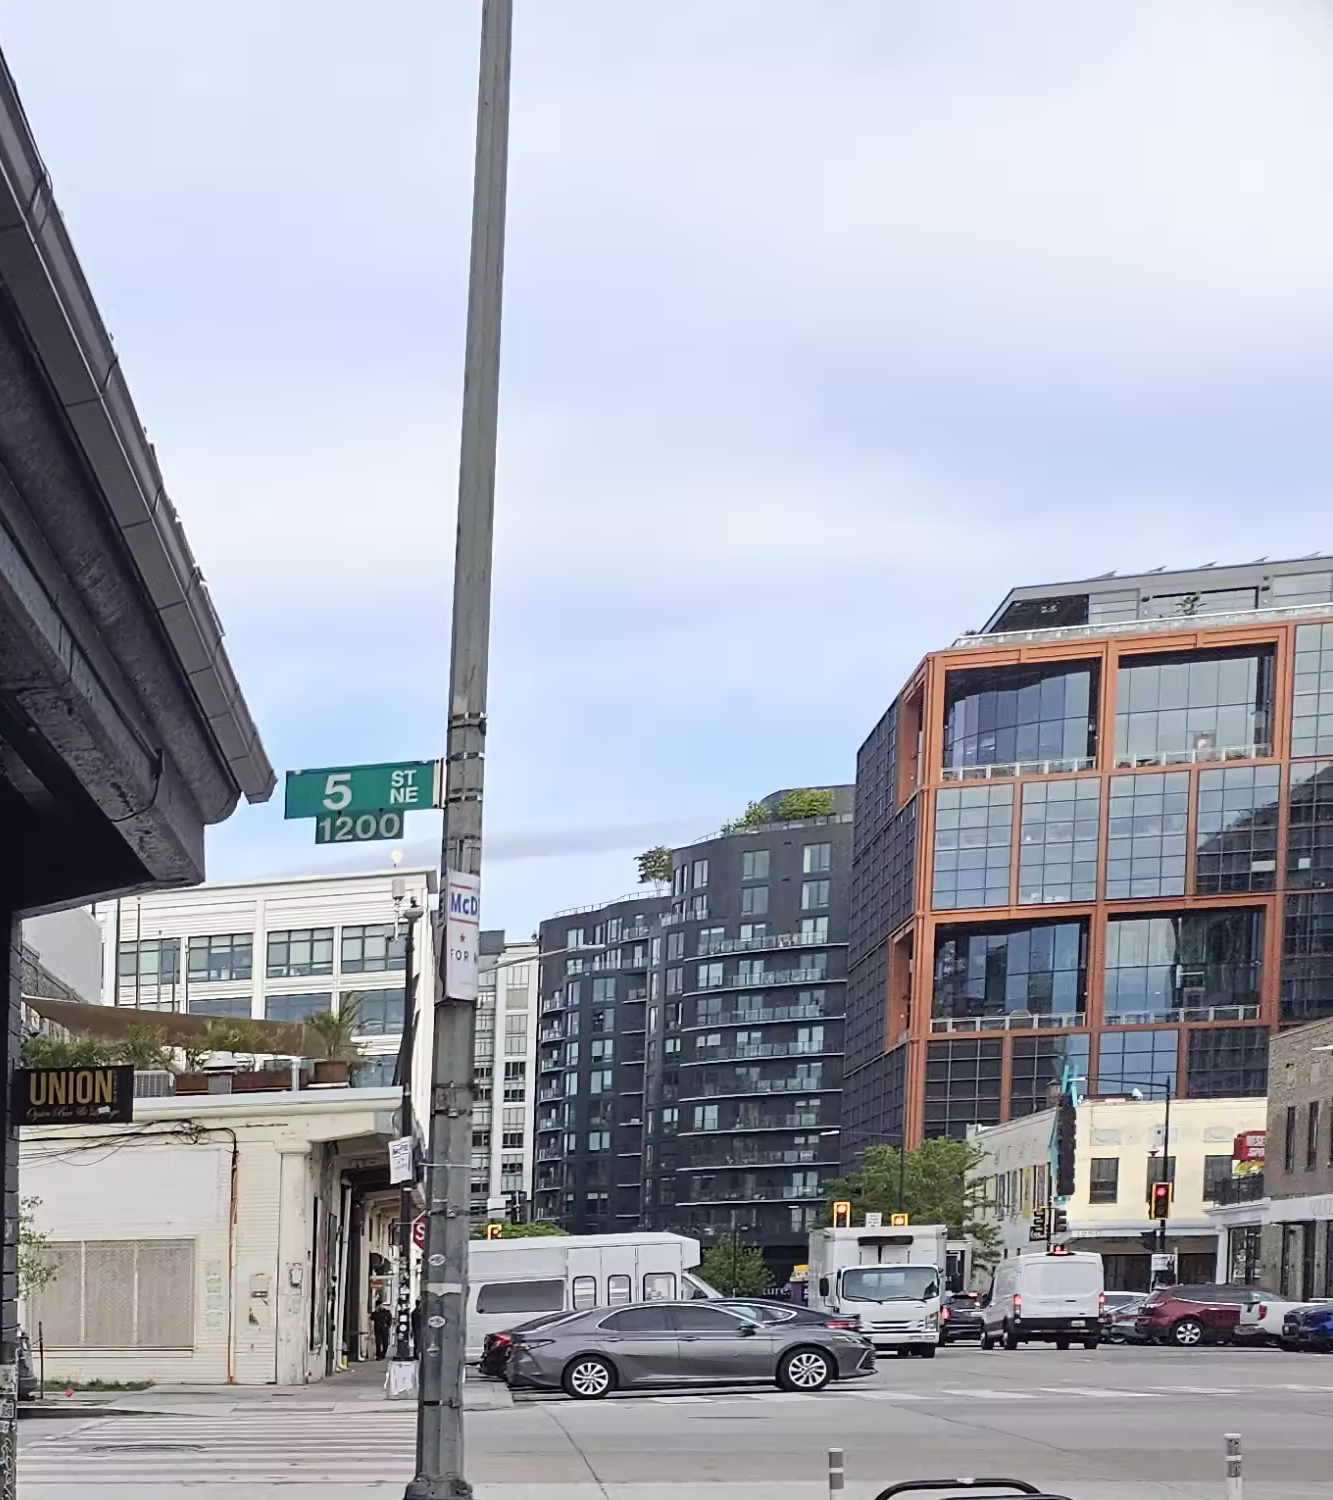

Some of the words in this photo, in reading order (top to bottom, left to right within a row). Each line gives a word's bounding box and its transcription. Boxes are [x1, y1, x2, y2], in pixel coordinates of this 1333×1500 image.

[391, 769, 417, 787] ST
[323, 773, 352, 811] 5
[390, 786, 418, 805] NE
[318, 812, 401, 842] 1200
[451, 949, 469, 962] FOR
[30, 1070, 113, 1106] UNION
